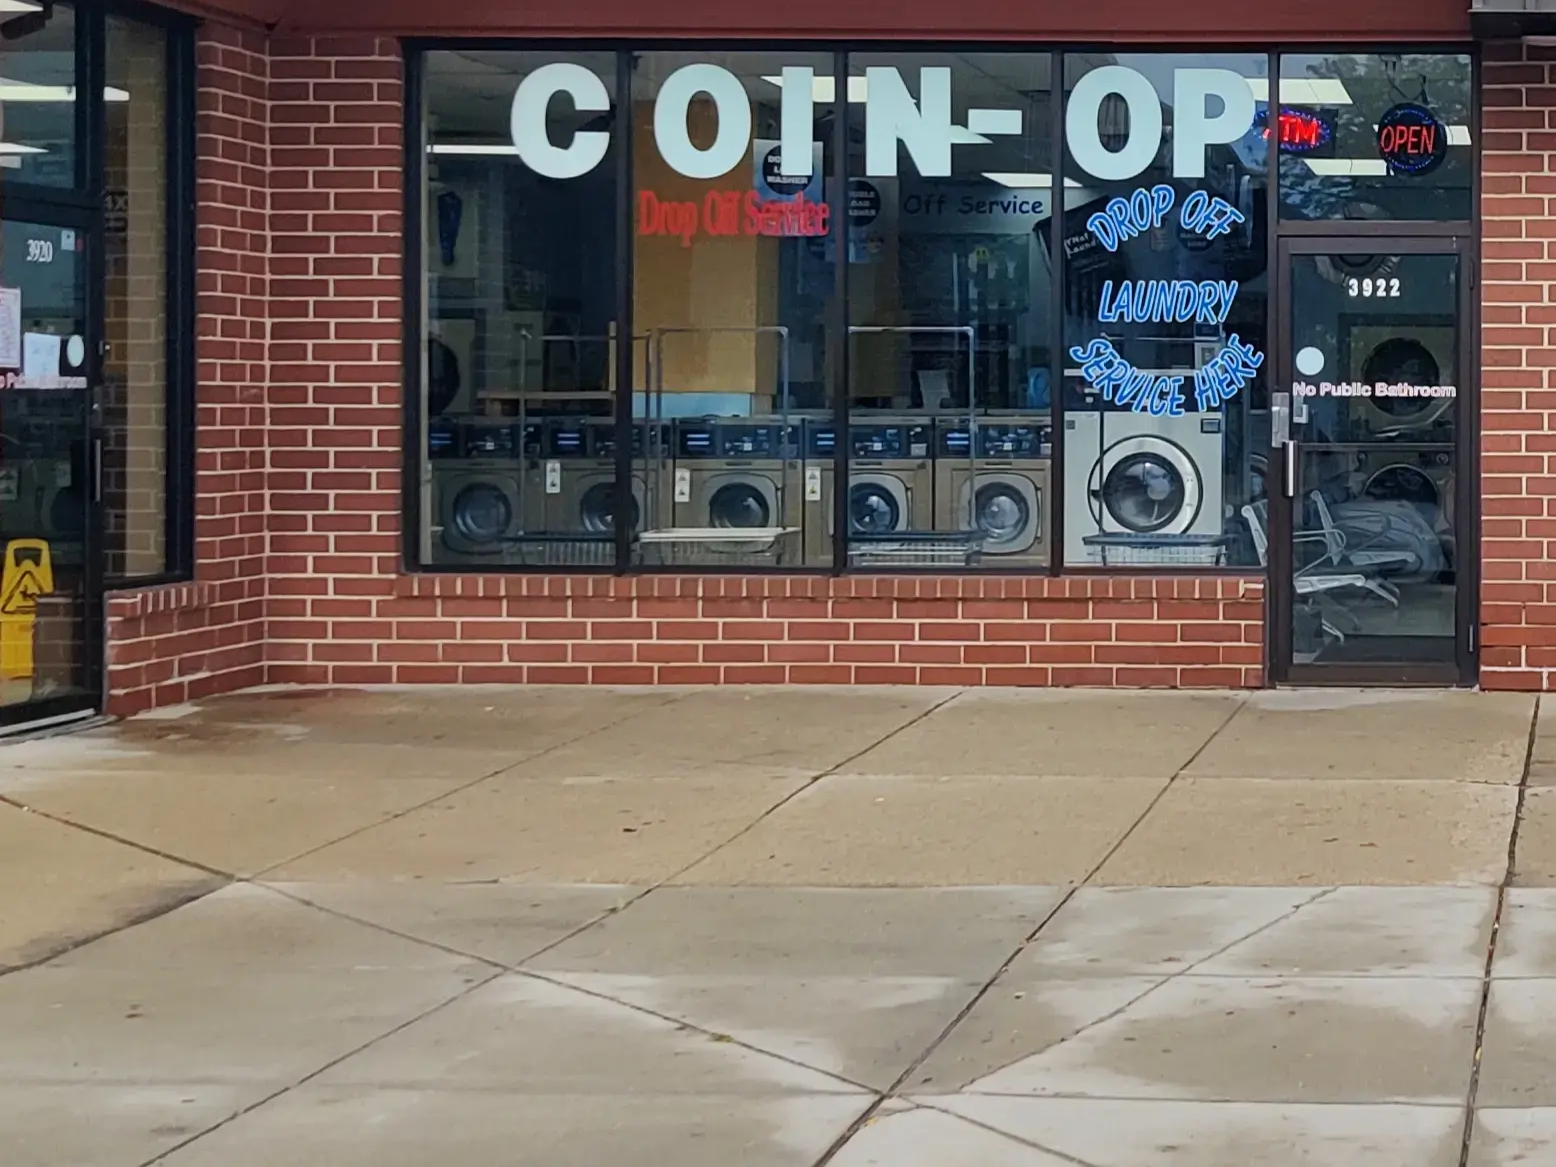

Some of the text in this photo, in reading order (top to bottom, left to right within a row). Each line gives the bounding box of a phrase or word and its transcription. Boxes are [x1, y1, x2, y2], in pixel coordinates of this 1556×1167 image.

[510, 62, 1256, 180] COIN-OP
[1263, 114, 1319, 145] TM
[1381, 126, 1434, 153] OPEN
[767, 176, 808, 184] WASHER
[638, 189, 830, 248] Drop Off Service
[904, 194, 1044, 215] Off Service
[1087, 184, 1245, 252] DROP OFF
[26, 239, 53, 263] 3920
[1098, 280, 1239, 324] LAUNDRY
[1348, 278, 1401, 297] 3922
[1069, 333, 1264, 417] SERVICE HERE
[1292, 381, 1457, 397] No Public Bathroom
